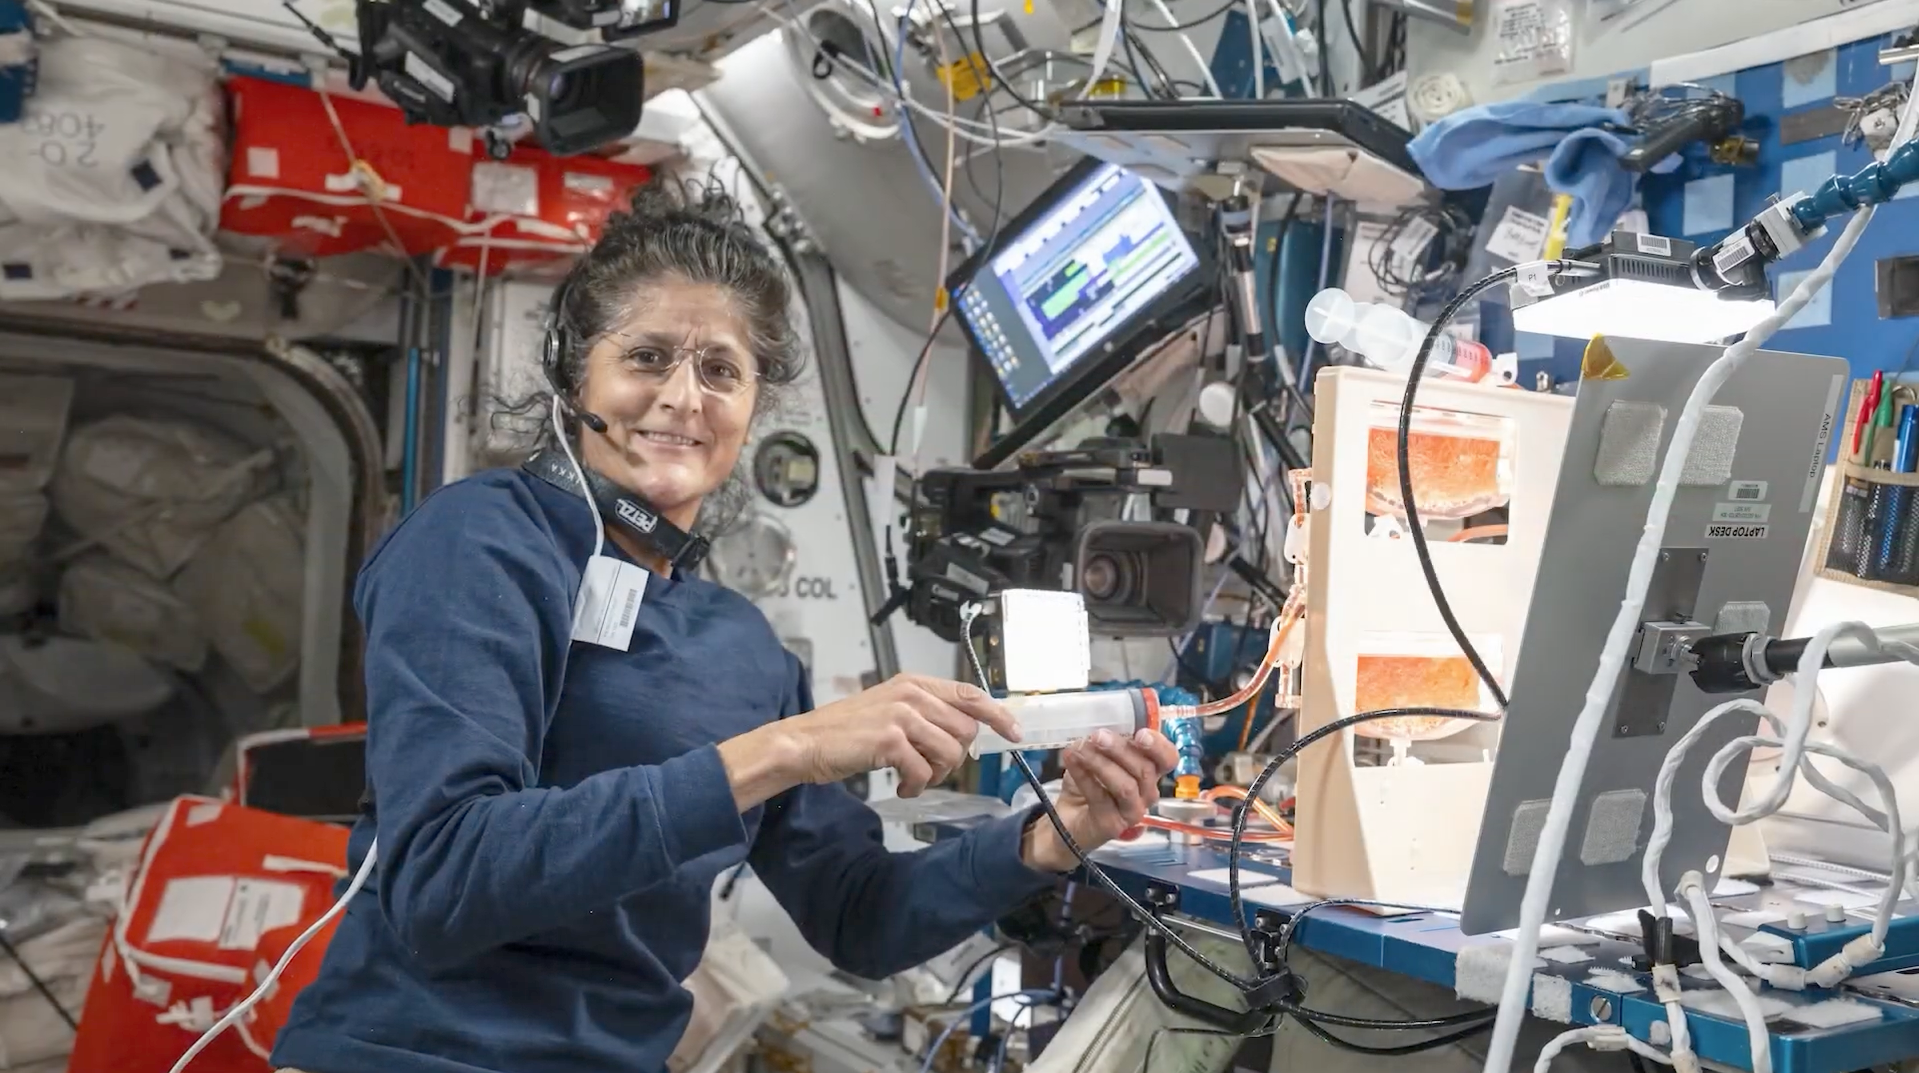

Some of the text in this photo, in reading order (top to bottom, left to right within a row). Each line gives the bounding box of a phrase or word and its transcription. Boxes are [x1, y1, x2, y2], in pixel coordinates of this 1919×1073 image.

[1528, 273, 1537, 281] P1
[1809, 413, 1832, 478] AMS Laptop
[616, 498, 658, 534] PETZL
[1709, 526, 1765, 537] LAPTOP DESK
[796, 577, 838, 598] COL
